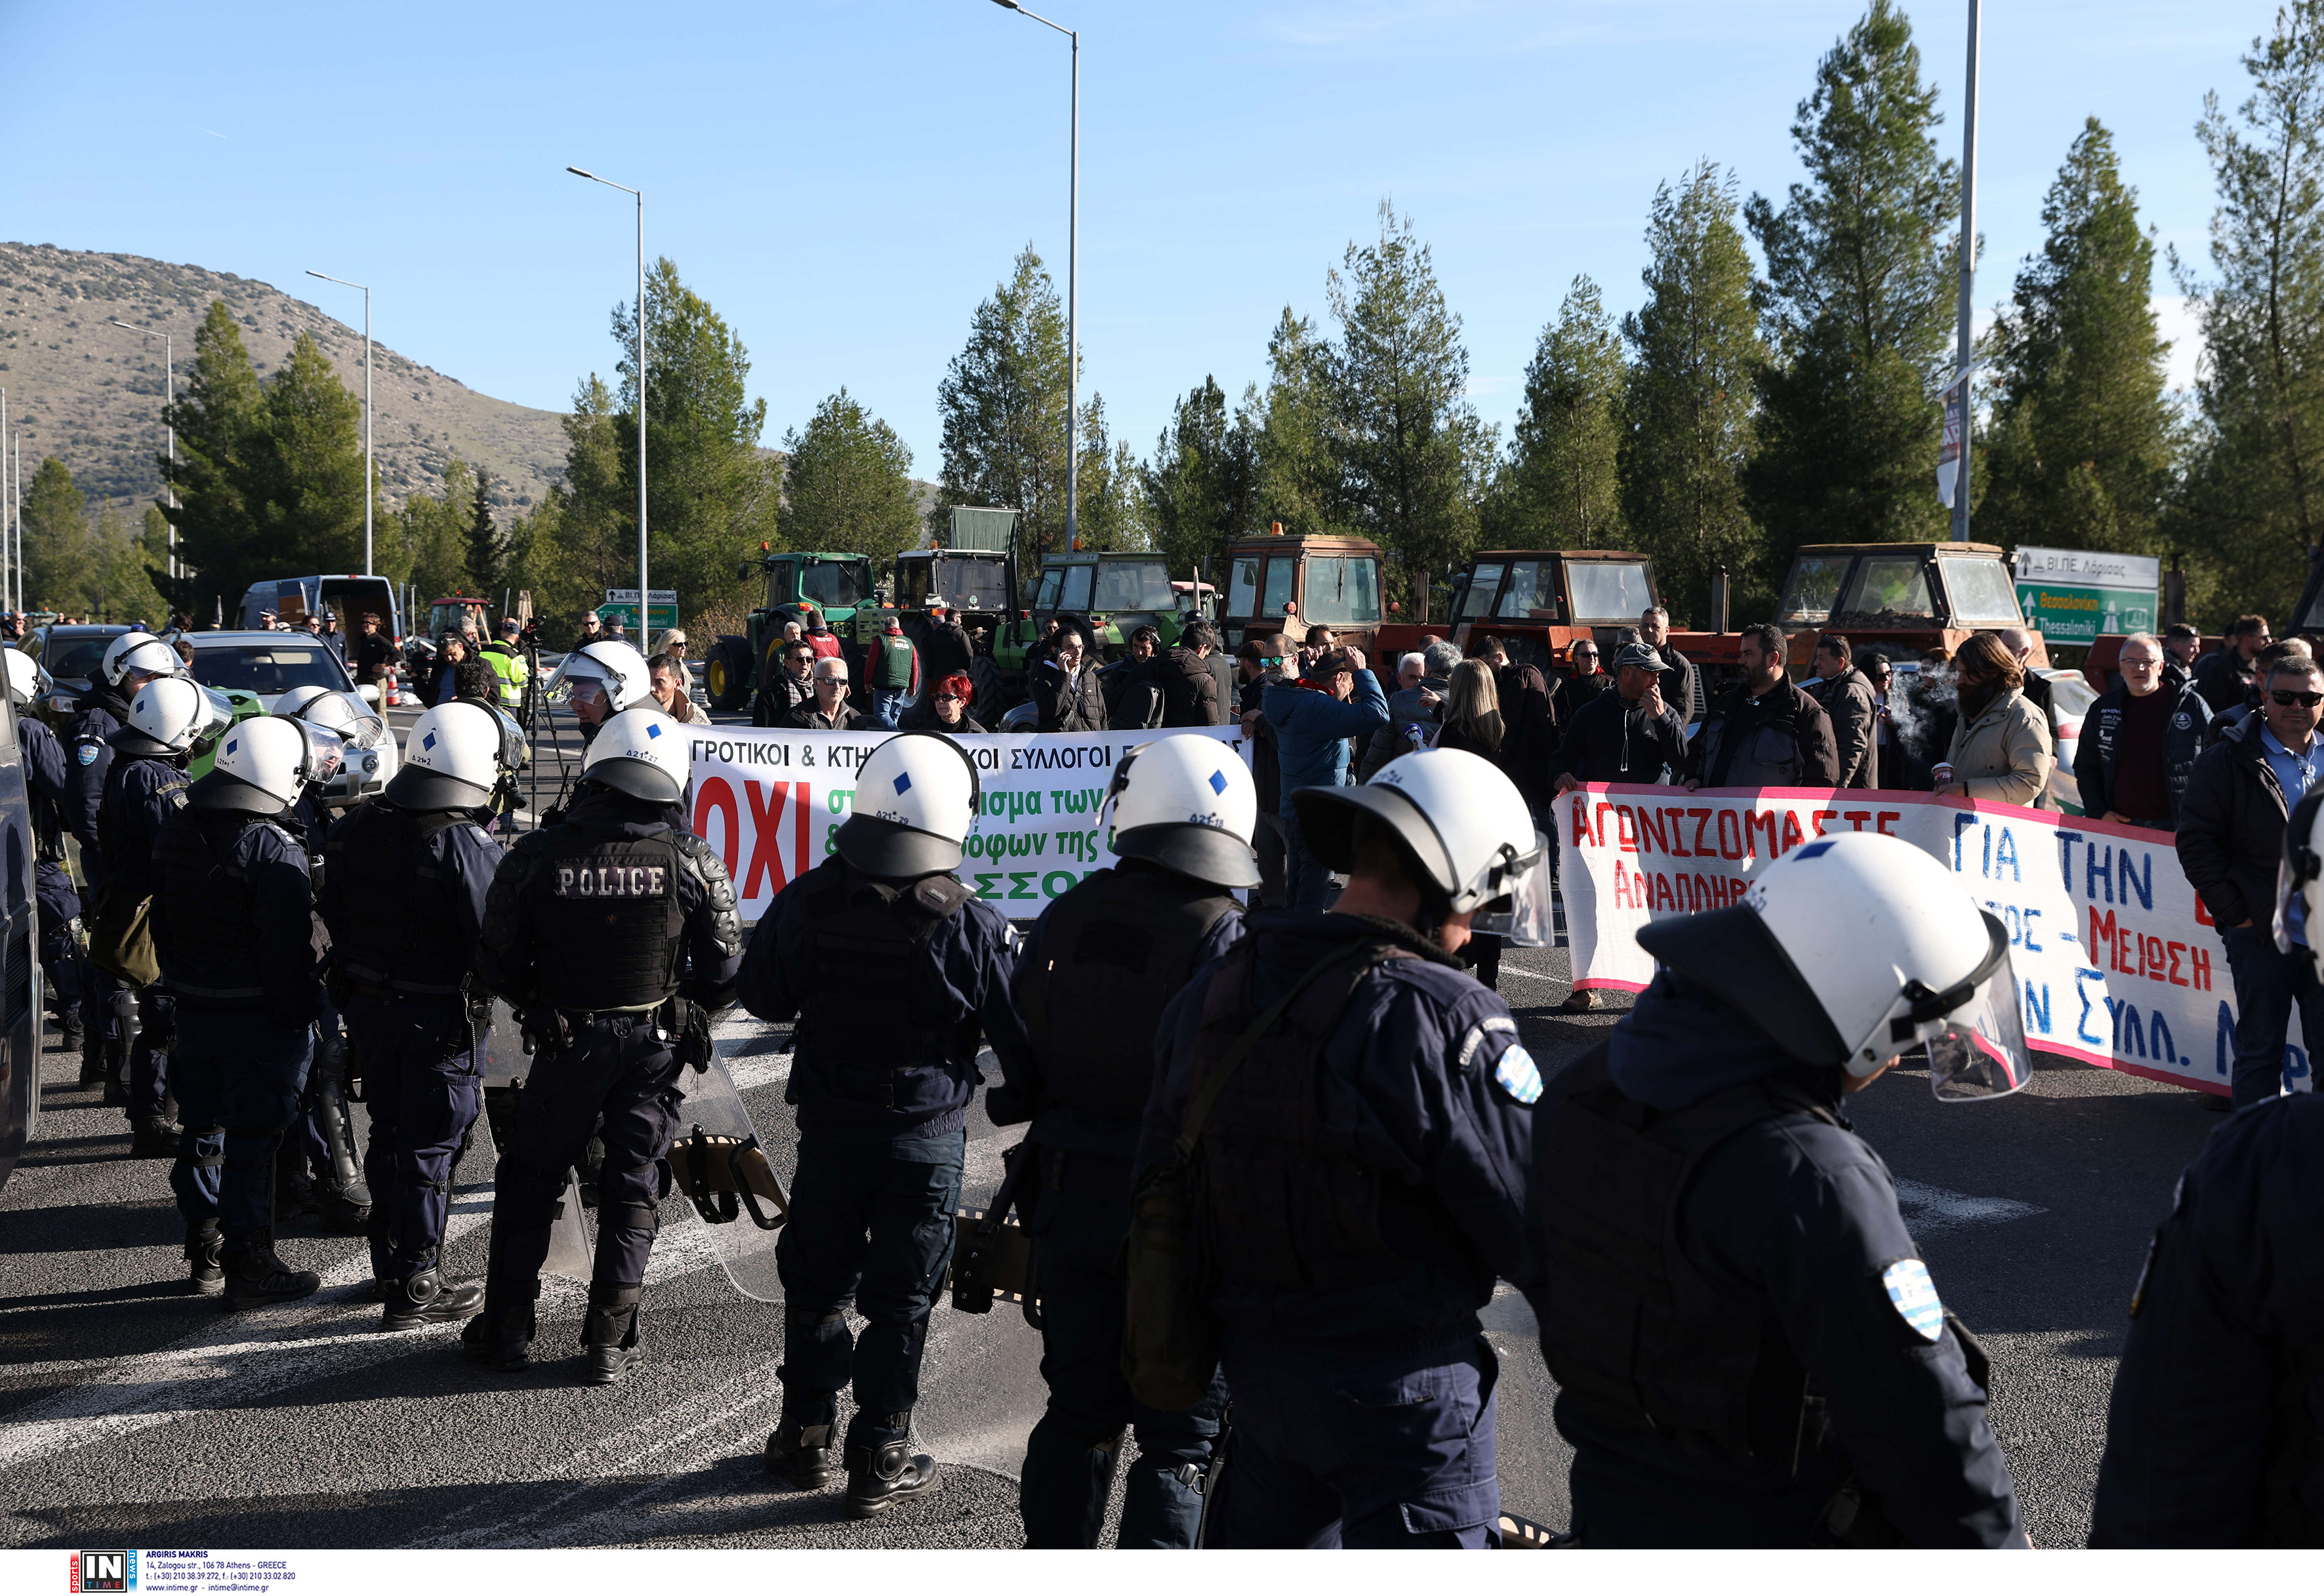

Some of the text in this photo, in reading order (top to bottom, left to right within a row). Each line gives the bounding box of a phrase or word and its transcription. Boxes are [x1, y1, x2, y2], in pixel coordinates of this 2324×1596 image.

[2040, 592, 2098, 611] Θεσσαλονίκη
[2039, 617, 2096, 636] Thessaloniki
[2131, 613, 2142, 624] A1
[693, 740, 789, 766] ΓΡΟΤΙΚΟΙ
[802, 745, 815, 767] &
[1011, 745, 1111, 769] ΣΥΛΛΟΓΟΙ
[973, 790, 1042, 824] ισμα
[1050, 788, 1104, 814] των
[693, 776, 811, 899] ΟΧΙ
[961, 825, 1048, 865] όφων
[1055, 830, 1099, 863] της
[1955, 812, 2022, 884] ΓΙΑ
[2054, 830, 2153, 912] ΤΗΝ
[559, 868, 664, 896] POLICE
[1614, 859, 1756, 912] ΑΝΑΠΛΗΡ
[2089, 905, 2212, 992] ΜΕΙΩΣΗ
